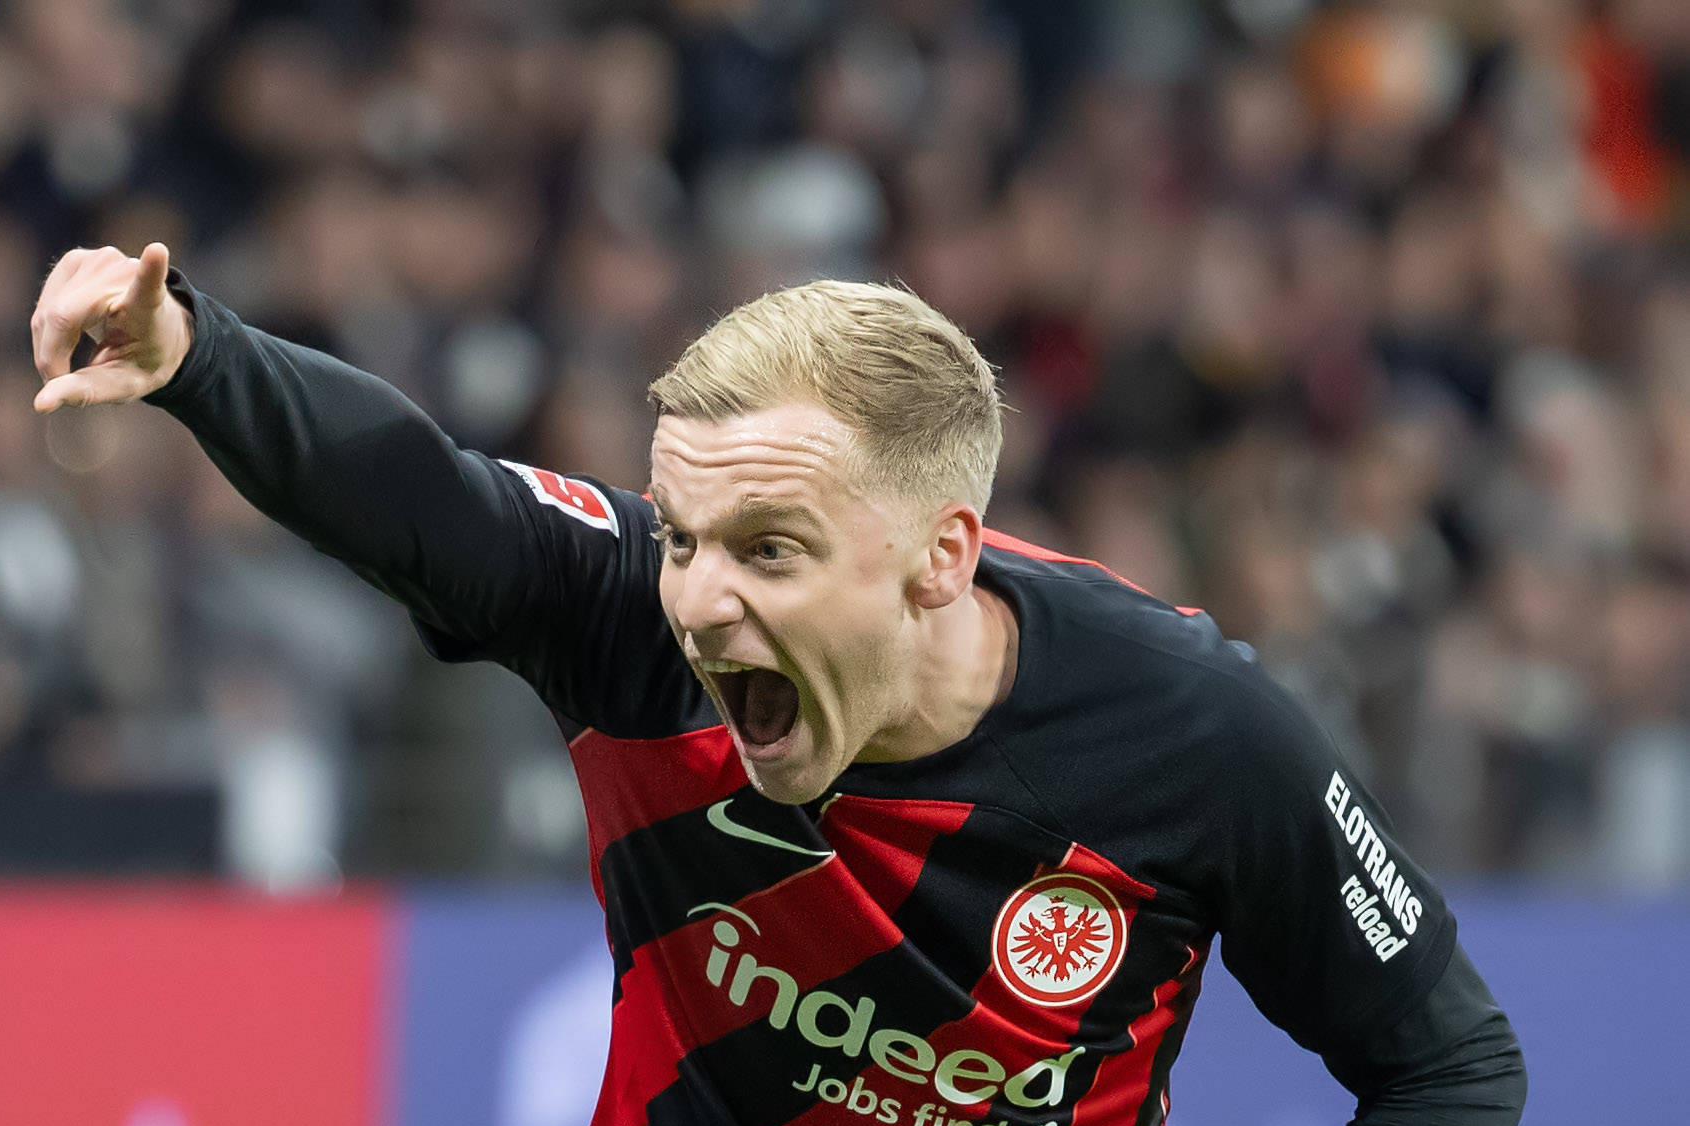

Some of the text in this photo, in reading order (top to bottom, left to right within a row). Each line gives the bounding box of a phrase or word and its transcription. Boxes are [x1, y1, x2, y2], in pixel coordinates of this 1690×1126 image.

[1324, 770, 1423, 935] ELOTRANS
[1340, 874, 1409, 963] reload
[688, 902, 1086, 1108] indeed
[792, 1063, 902, 1125] Jobs
